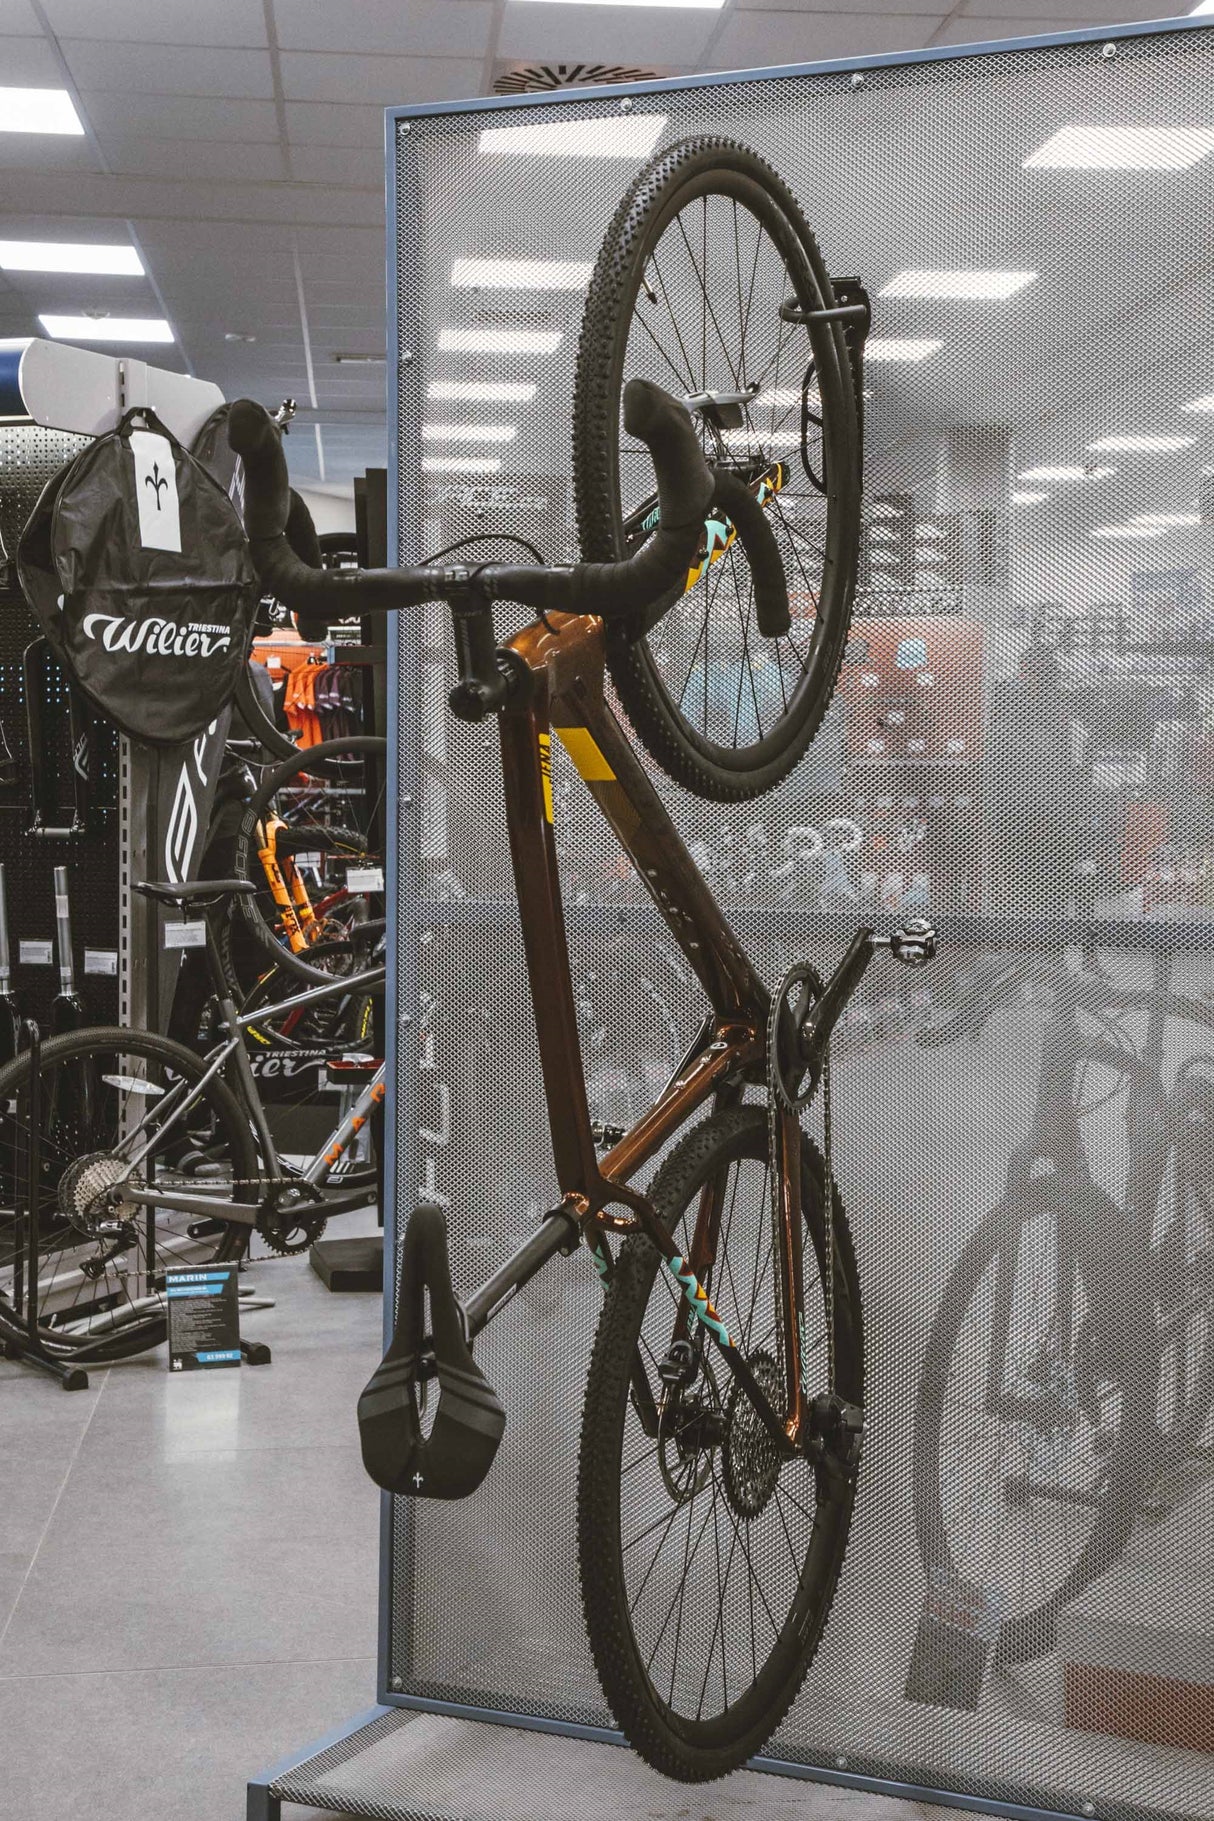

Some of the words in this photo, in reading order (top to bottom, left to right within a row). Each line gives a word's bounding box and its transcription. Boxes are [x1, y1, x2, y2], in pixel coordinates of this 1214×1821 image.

[188, 623, 231, 635] TRIESTINA
[82, 613, 231, 658] Wilier
[265, 1049, 327, 1059] TRIESTINA
[168, 1273, 208, 1283] MARIN
